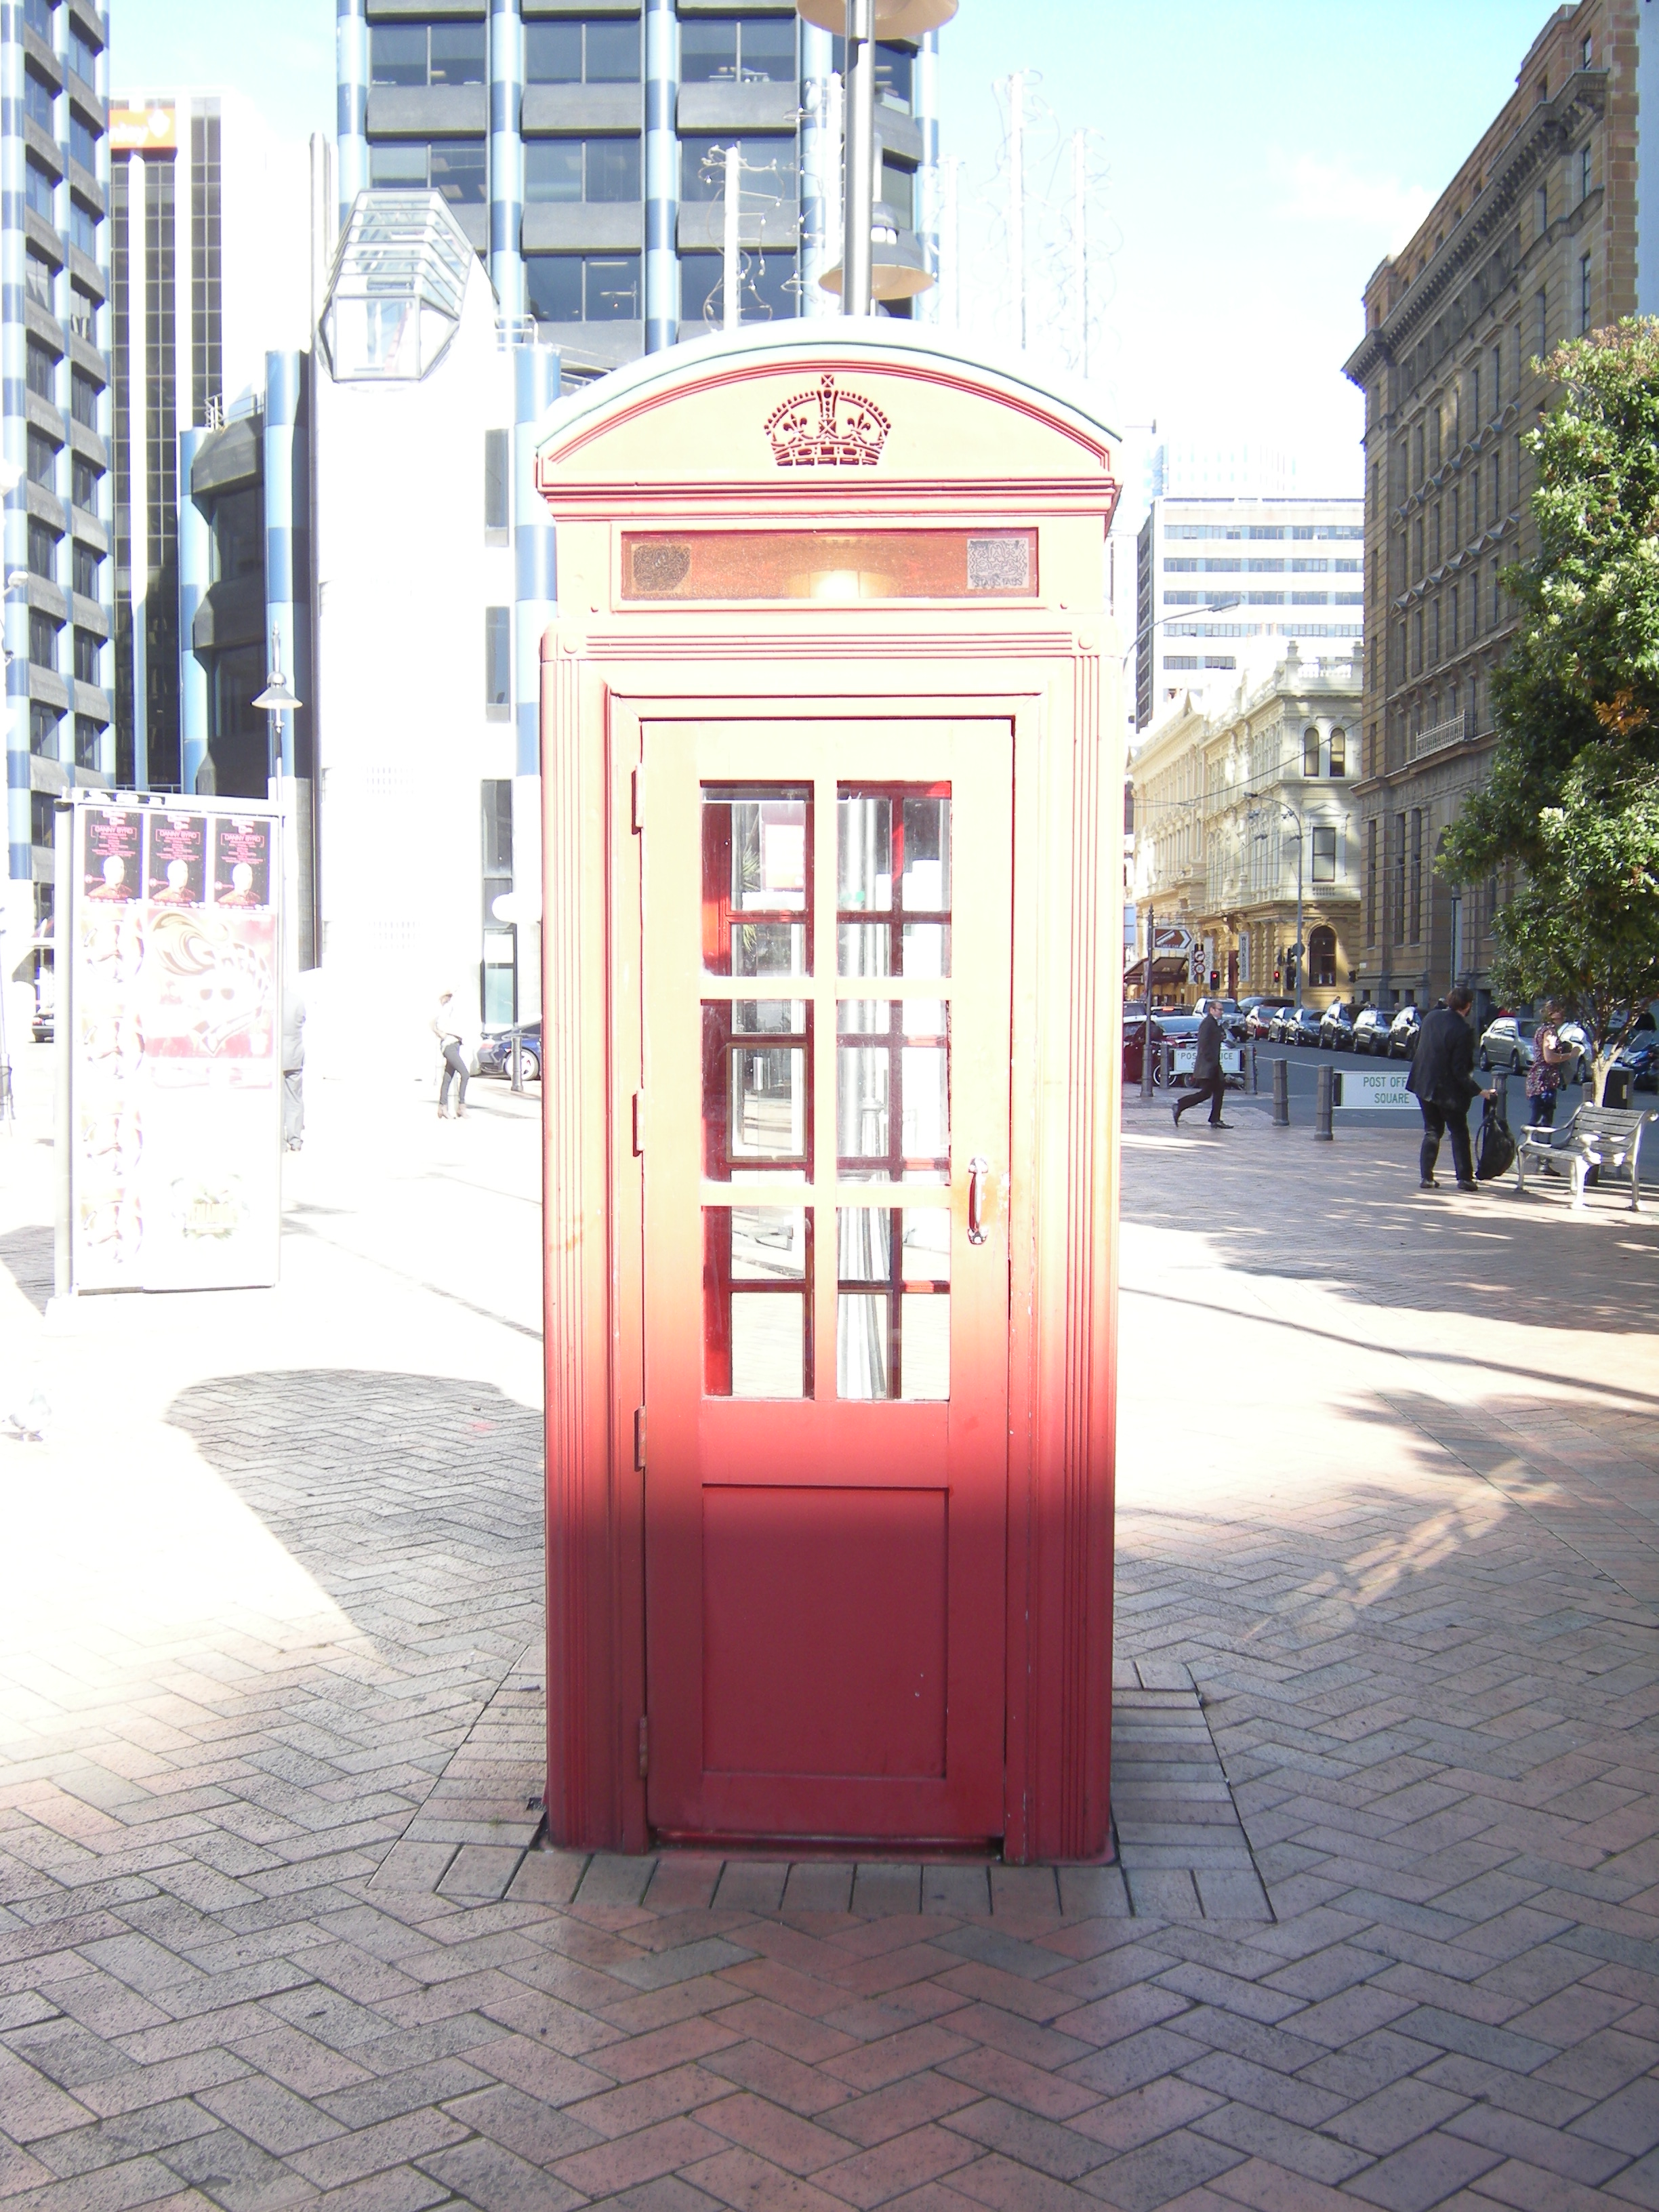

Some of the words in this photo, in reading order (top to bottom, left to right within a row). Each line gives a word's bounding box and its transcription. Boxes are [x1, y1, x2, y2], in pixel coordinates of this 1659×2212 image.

[1363, 1077, 1386, 1087] POST
[1390, 1077, 1408, 1088] OFF
[1374, 1093, 1410, 1103] SQUARE
